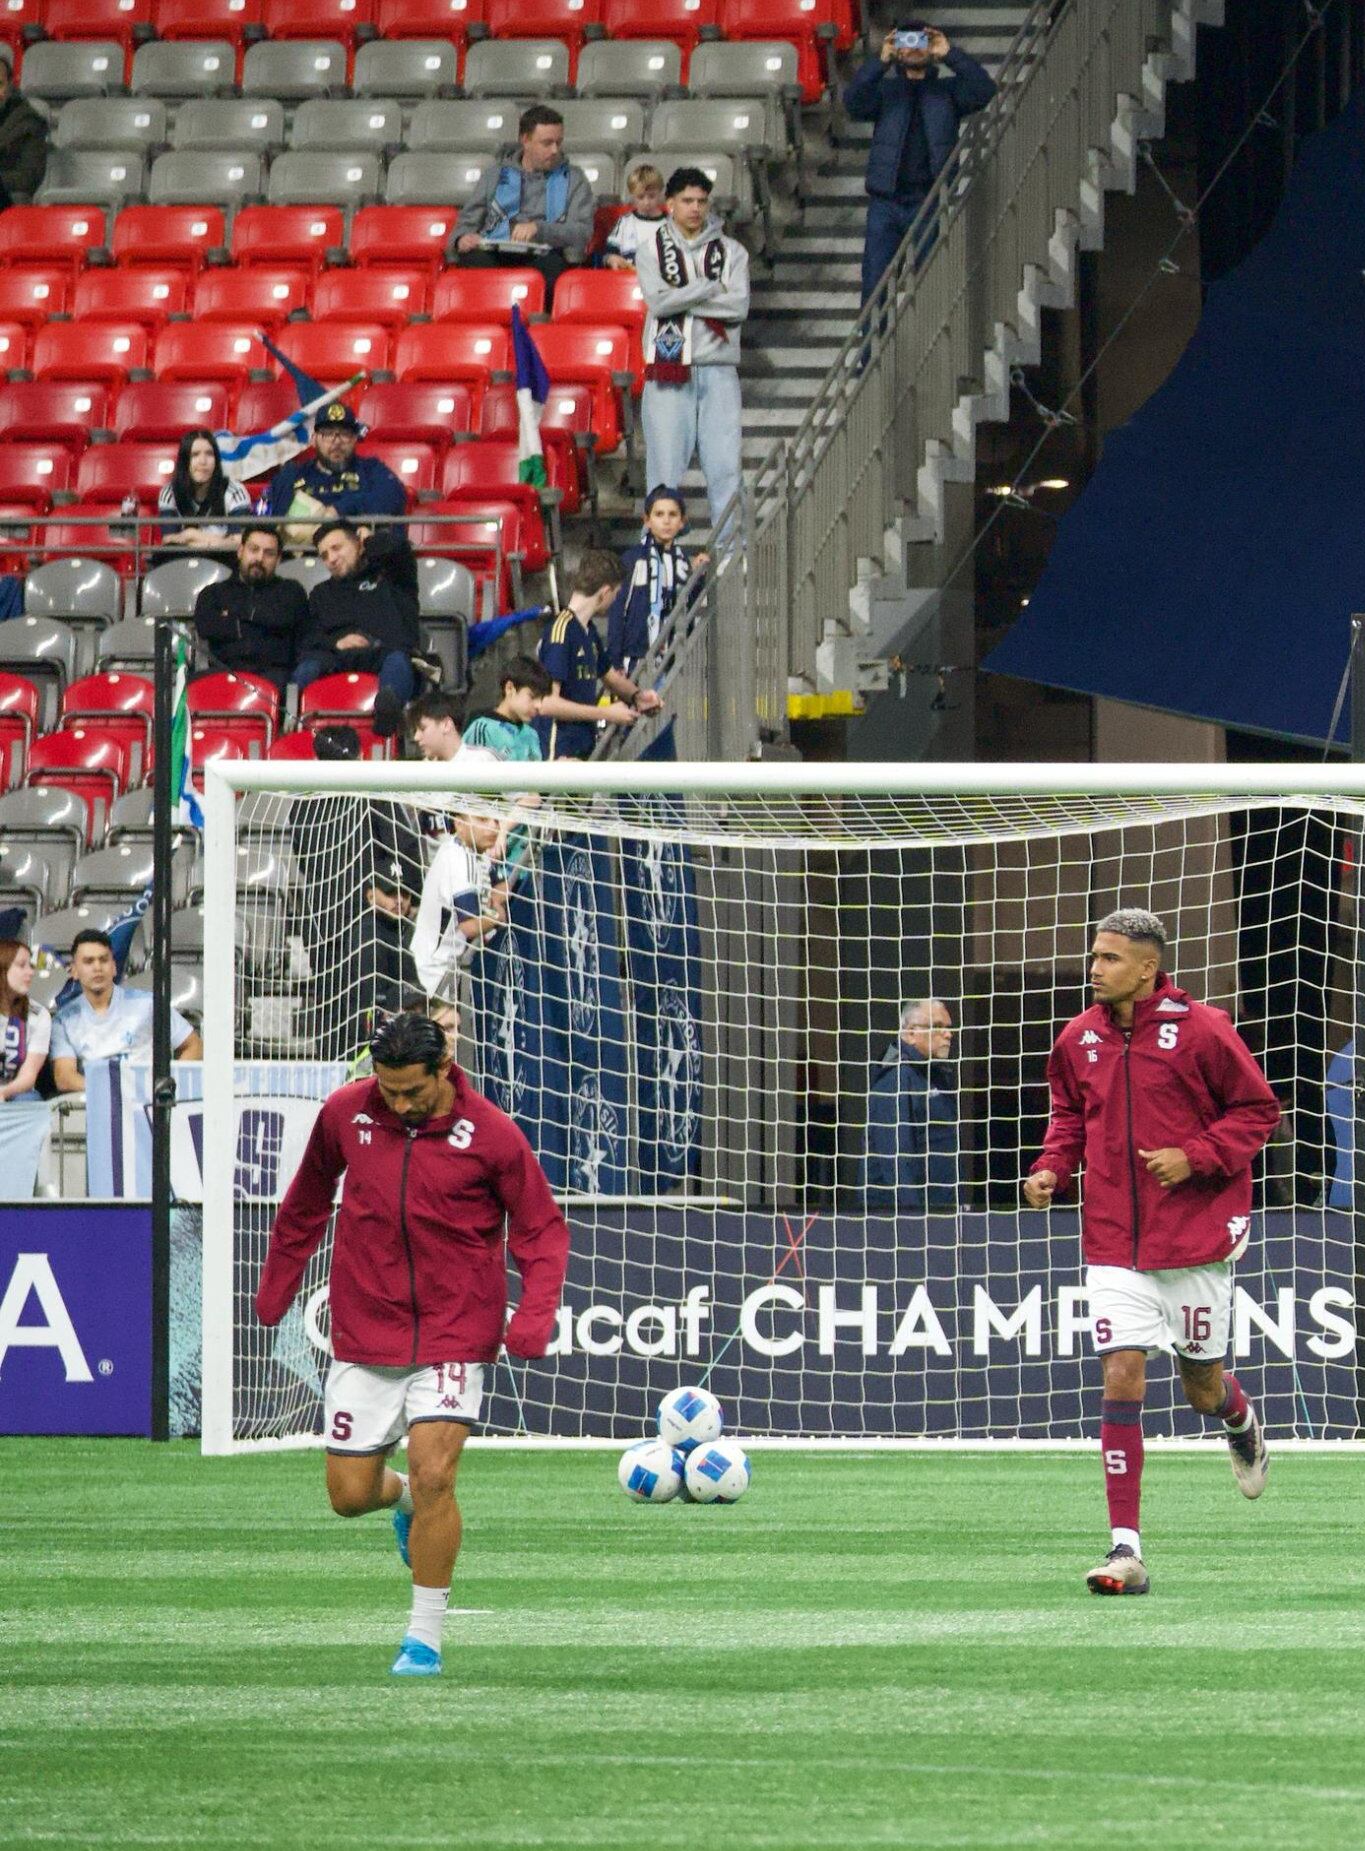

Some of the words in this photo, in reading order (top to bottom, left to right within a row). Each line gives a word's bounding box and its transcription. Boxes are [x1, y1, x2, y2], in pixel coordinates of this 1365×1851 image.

[1158, 1023, 1178, 1050] S
[1086, 1050, 1098, 1063] 16
[358, 1130, 371, 1145] 14
[448, 1119, 475, 1149] S
[740, 1285, 1355, 1358] CHAMPNS
[1095, 1318, 1113, 1344] S
[1181, 1305, 1212, 1341] 16
[433, 1361, 467, 1395] 14
[332, 1411, 353, 1440] S
[1105, 1450, 1127, 1475] S
